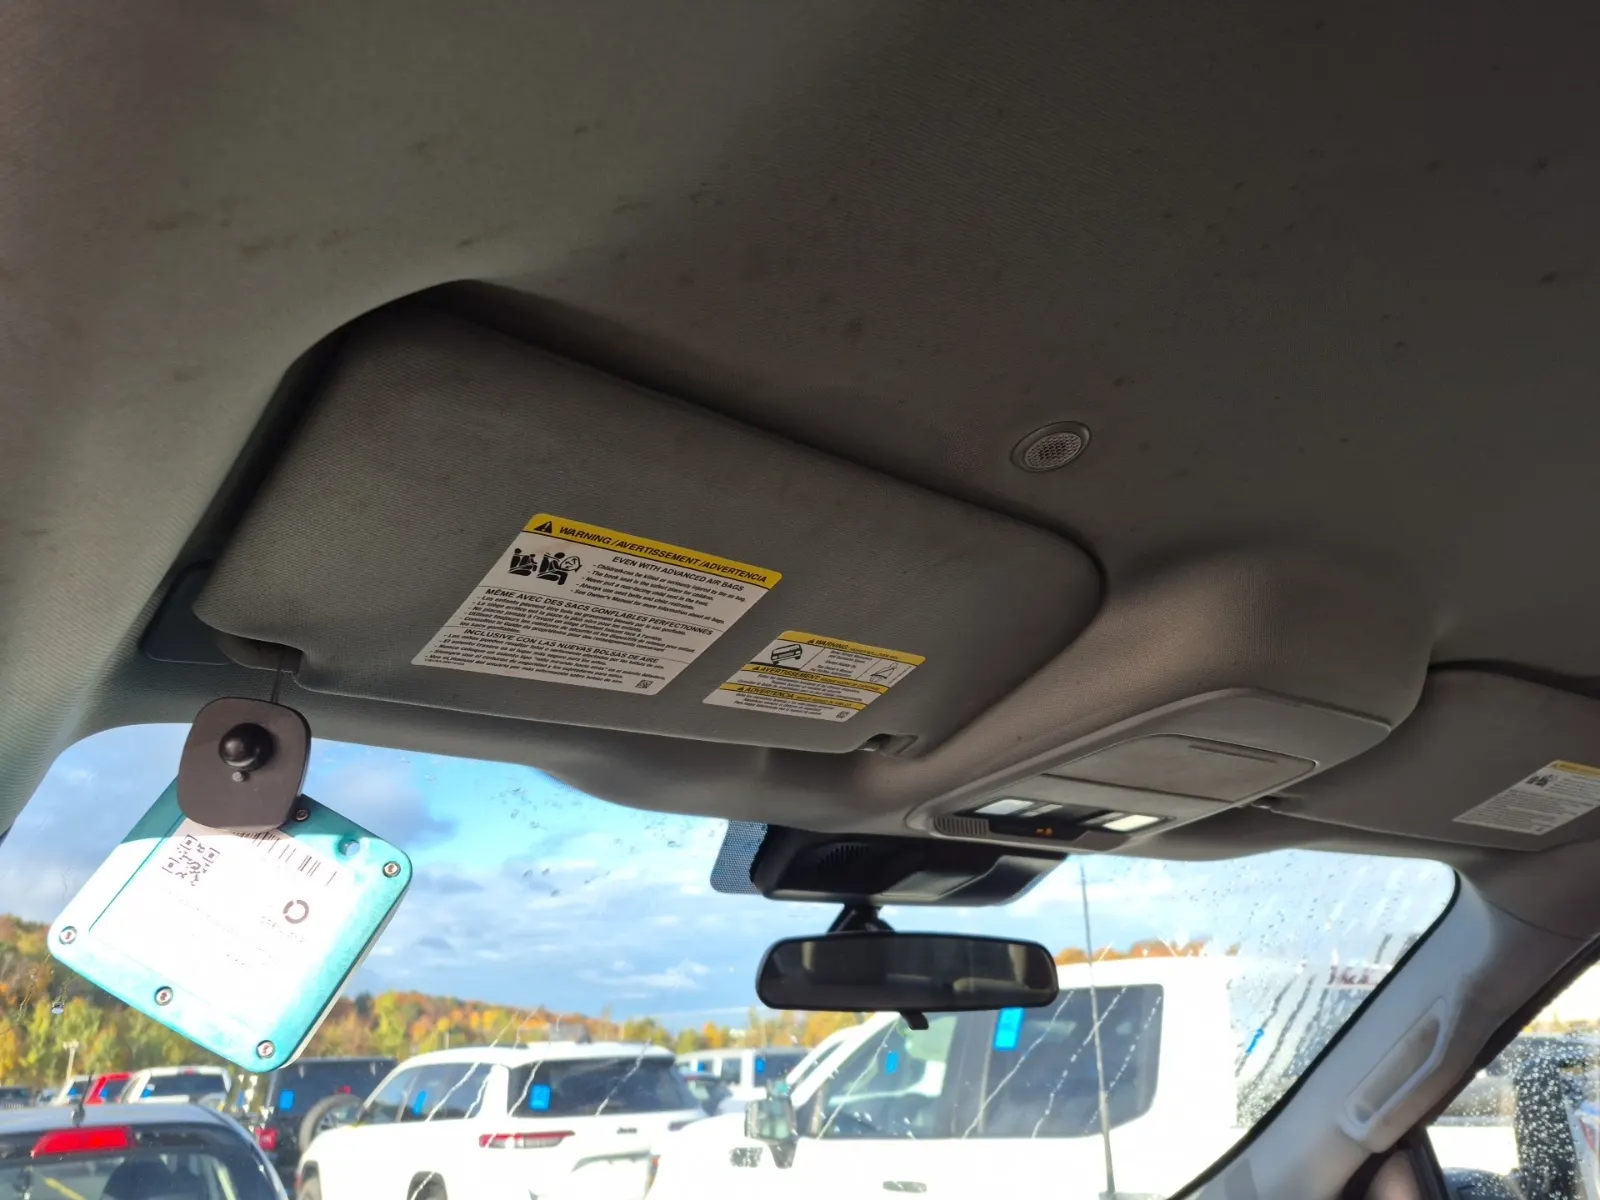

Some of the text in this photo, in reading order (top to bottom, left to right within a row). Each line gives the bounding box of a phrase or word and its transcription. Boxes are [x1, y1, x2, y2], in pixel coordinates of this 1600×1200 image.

[559, 527, 766, 582] WARNING /AVERTISSEMENT /ADVERTENCIA
[612, 556, 744, 591] EVEN WITH ADVANCED AIR BAGS
[485, 588, 516, 598] MÊME
[516, 593, 543, 603] AVEC
[543, 598, 564, 606] DES
[564, 602, 590, 611] SACS
[591, 607, 648, 622] GONFLABLES
[464, 629, 515, 640] INCLUSIVE
[516, 636, 537, 644] CON
[557, 643, 592, 652] NUEVAS
[593, 648, 627, 658] BOLSAS
